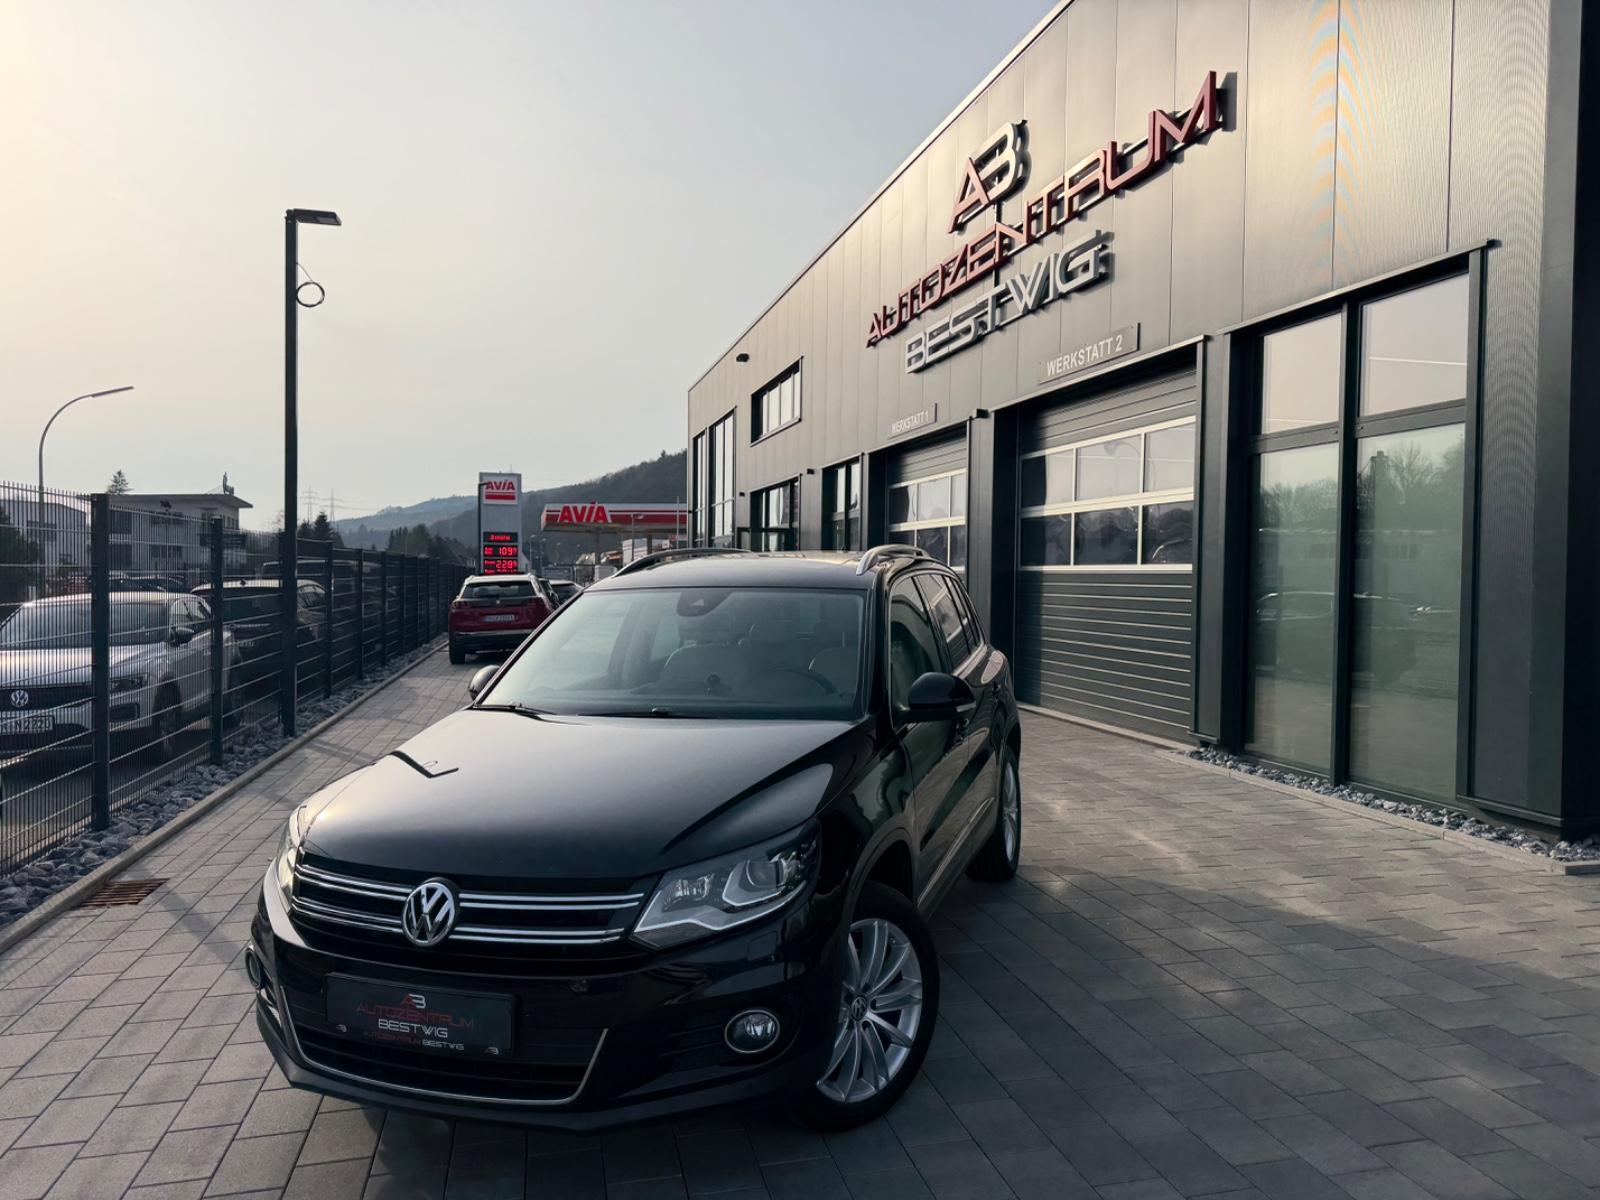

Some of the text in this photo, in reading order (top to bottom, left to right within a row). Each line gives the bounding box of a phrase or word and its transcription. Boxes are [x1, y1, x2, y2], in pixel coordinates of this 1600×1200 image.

[866, 71, 1218, 348] AUTOZENTRUM
[905, 230, 1105, 374] BESTWIG
[1046, 333, 1123, 377] WERKSTATT 2
[891, 411, 924, 433] WERKSTATT
[485, 479, 516, 491] AVIA
[559, 500, 609, 523] AVIA
[356, 1003, 474, 1030] AUTOZENTRUM
[378, 1018, 449, 1038] BESTWIG
[422, 1038, 465, 1051] BESTWIG
